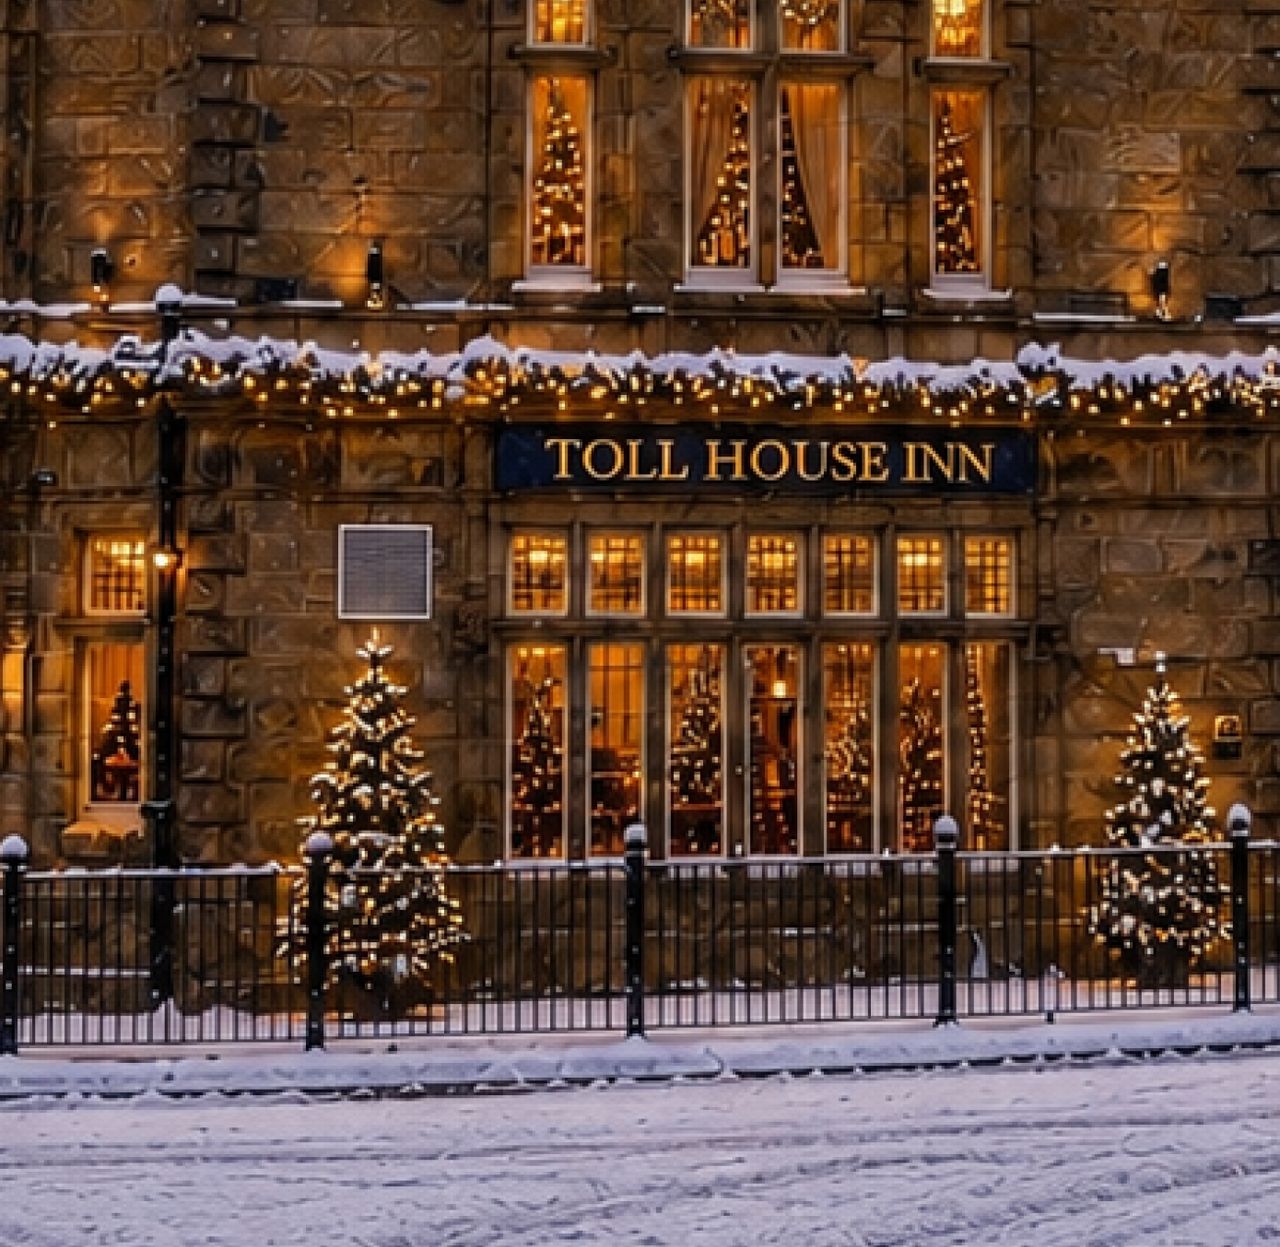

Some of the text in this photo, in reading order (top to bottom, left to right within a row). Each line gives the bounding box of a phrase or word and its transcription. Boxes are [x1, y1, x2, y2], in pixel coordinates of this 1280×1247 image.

[544, 438, 994, 484] TOLL HOUSE INN
